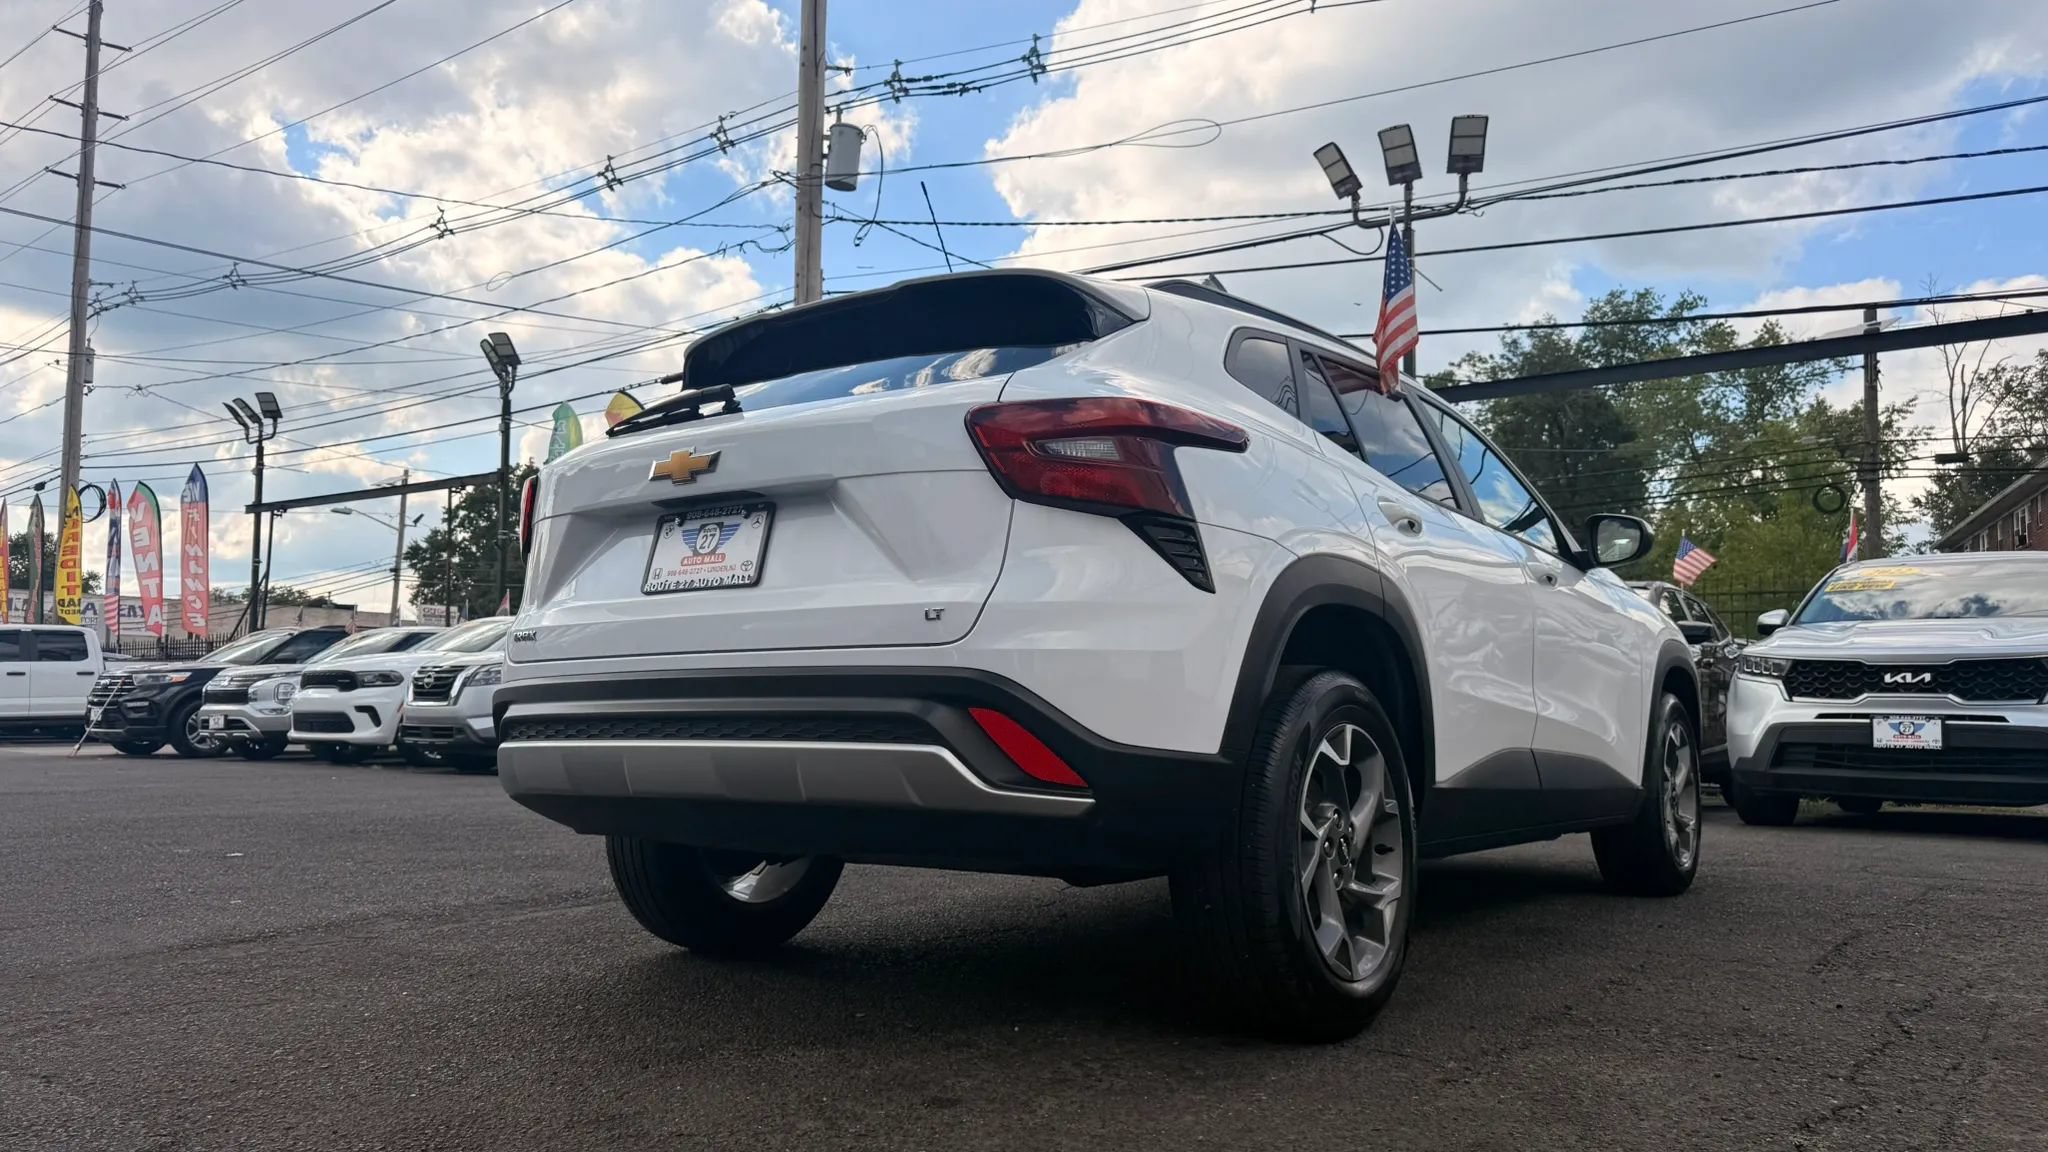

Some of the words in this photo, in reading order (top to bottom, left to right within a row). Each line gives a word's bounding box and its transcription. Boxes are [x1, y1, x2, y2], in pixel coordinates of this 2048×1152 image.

[699, 533, 717, 550] 27
[683, 556, 702, 566] AUTO
[704, 554, 723, 563] MALL
[644, 579, 677, 591] ROUTE
[679, 579, 691, 589] 27
[693, 577, 720, 588] AUTO
[723, 574, 751, 585] MALL
[925, 608, 945, 621] LT
[1884, 672, 1931, 684] KIA
